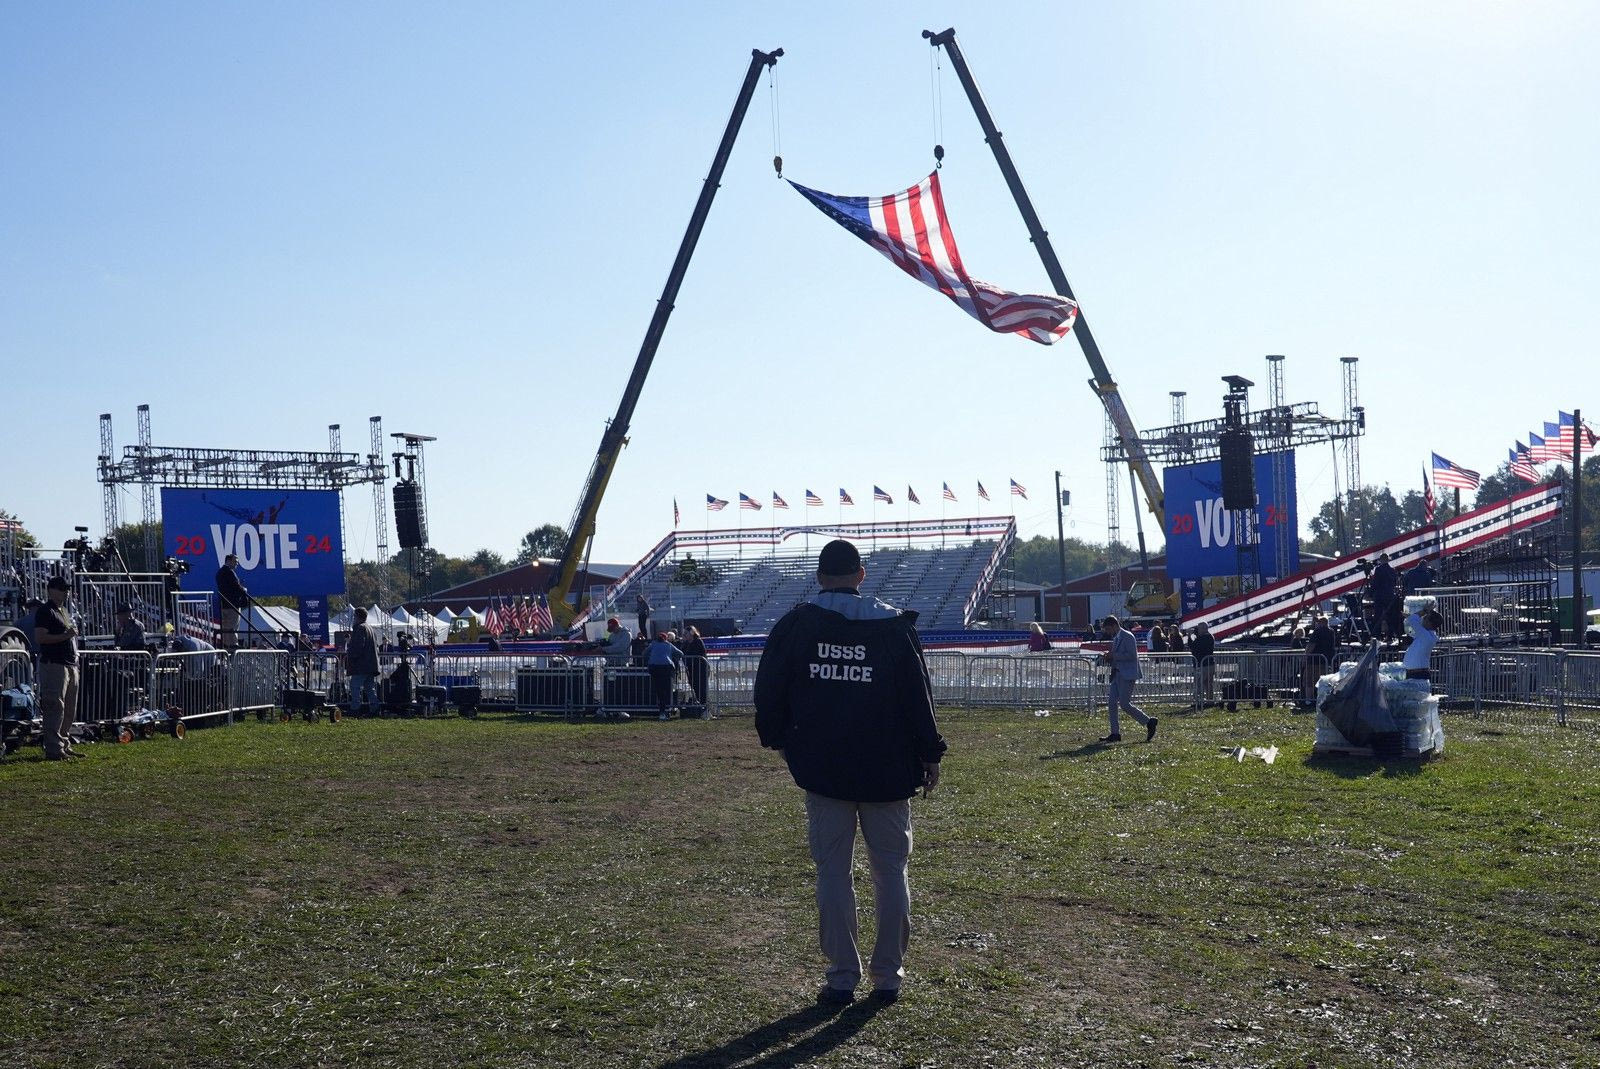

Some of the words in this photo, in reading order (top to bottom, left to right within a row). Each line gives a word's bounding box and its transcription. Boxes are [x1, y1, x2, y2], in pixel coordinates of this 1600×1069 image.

[1172, 514, 1194, 534] 20
[175, 536, 206, 555] 20
[210, 523, 299, 570] VOTE
[304, 535, 332, 554] 24
[817, 642, 866, 661] USSS
[809, 663, 873, 683] POLICE
